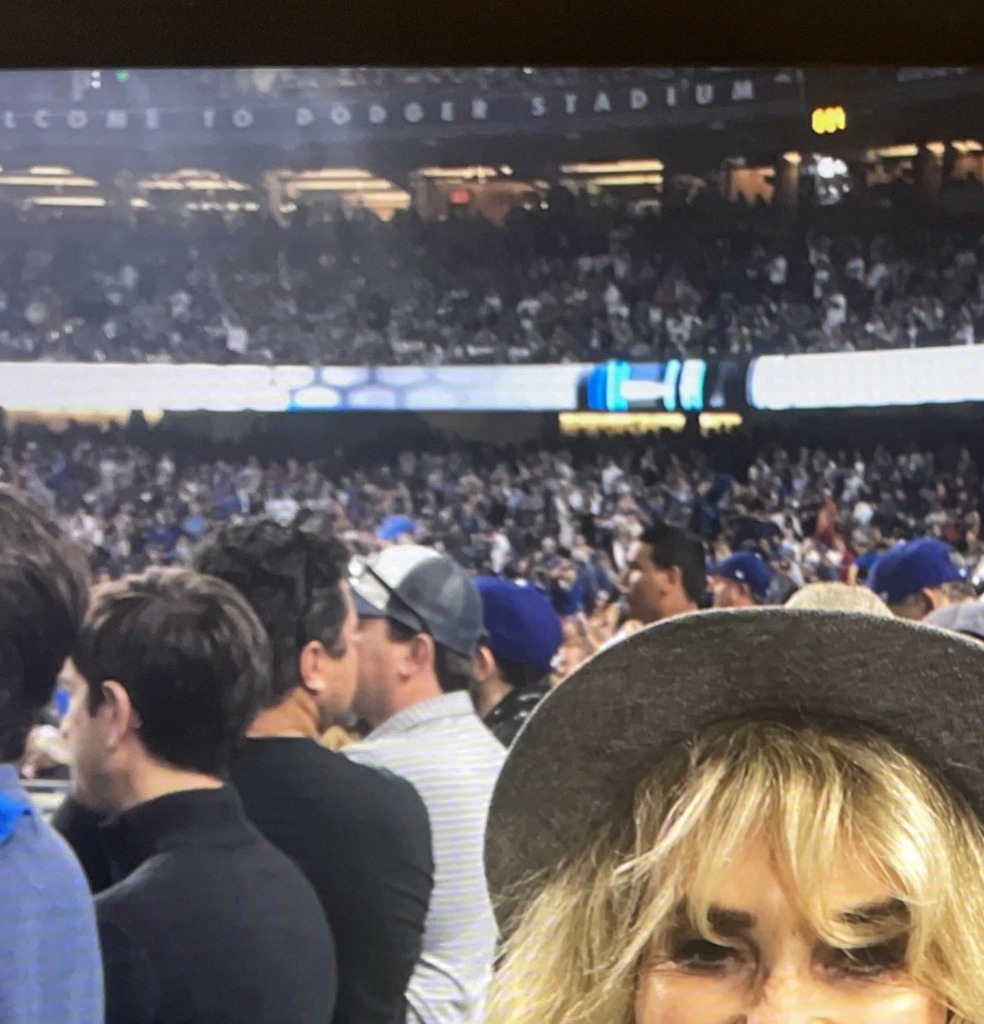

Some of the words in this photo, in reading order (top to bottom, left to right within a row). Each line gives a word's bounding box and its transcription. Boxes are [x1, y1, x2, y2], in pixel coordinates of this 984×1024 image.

[203, 107, 254, 129] TO
[296, 99, 488, 127] DODGER
[530, 79, 755, 117] STADIUM
